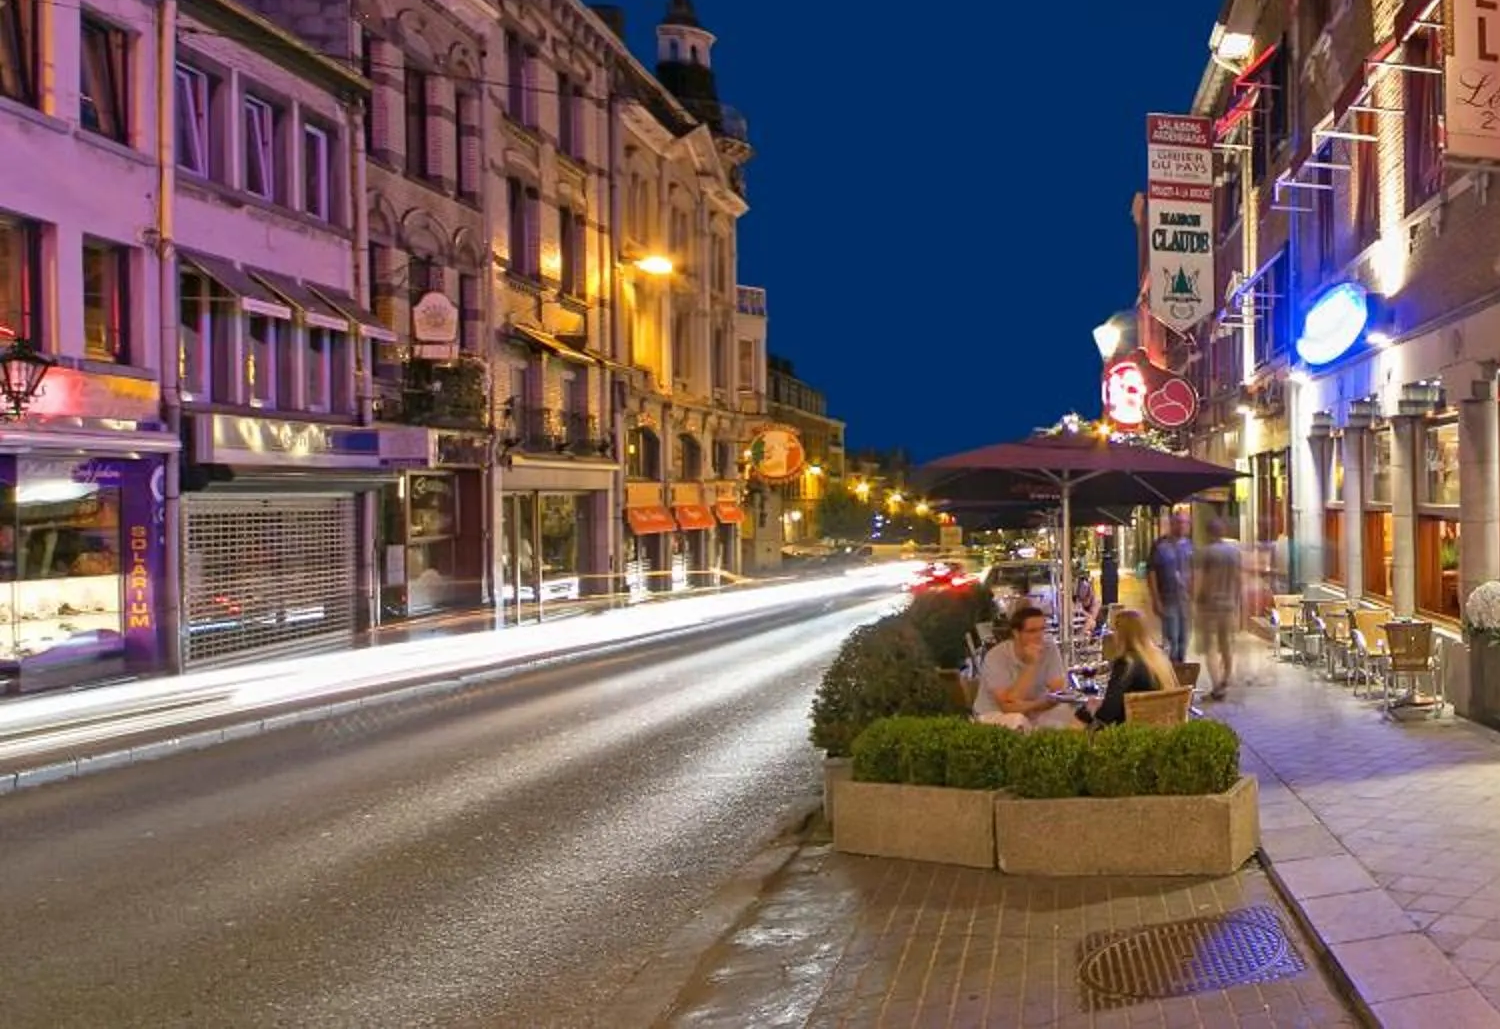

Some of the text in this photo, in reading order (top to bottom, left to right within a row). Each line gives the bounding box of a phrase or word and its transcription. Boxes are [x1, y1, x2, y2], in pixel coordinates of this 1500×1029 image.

[1480, 111, 1499, 131] 2
[1157, 151, 1204, 163] GIBIER
[1151, 160, 1171, 170] DU
[1175, 162, 1208, 175] PAYS
[1152, 228, 1210, 253] CLAUDE
[129, 524, 150, 629] SOLARIUM
